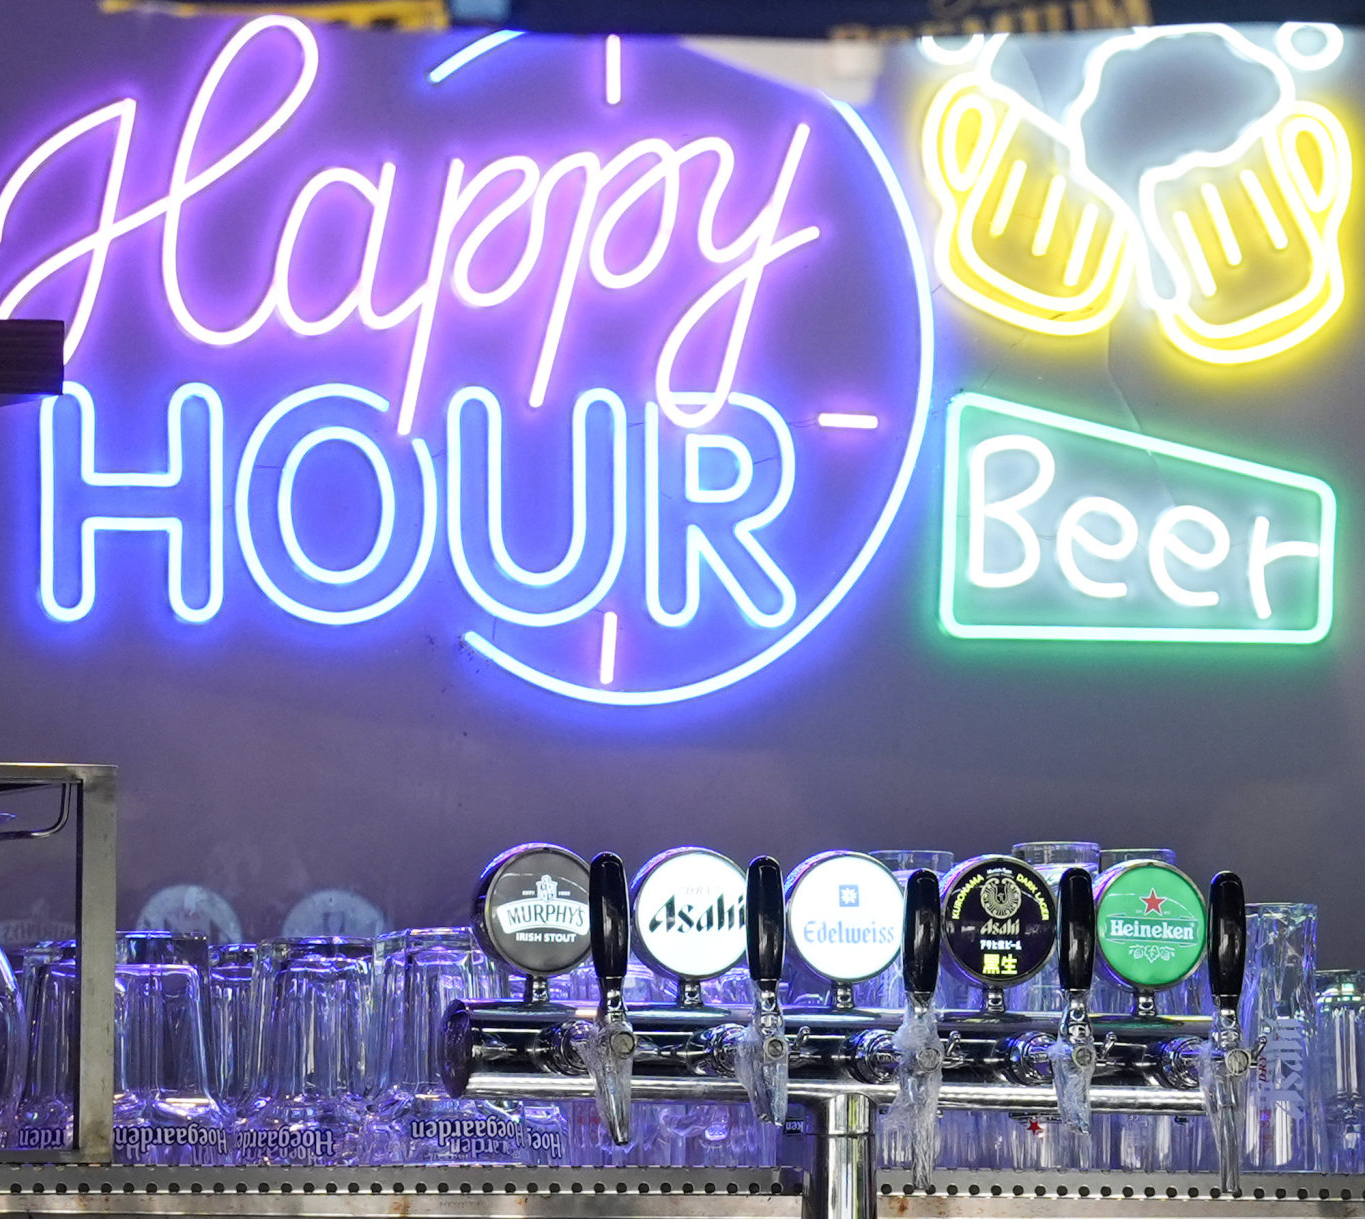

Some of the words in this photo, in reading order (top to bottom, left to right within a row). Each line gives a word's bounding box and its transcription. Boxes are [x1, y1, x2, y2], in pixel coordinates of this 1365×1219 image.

[39, 380, 797, 630] HOUR
[966, 434, 1321, 620] Beer
[951, 873, 985, 920] KURONAMA
[1016, 873, 1038, 894] DARK
[1035, 891, 1050, 921] LAGER
[506, 902, 586, 927] MURPHY'S
[648, 893, 747, 934] Asahi
[980, 918, 1020, 935] Asahi
[515, 932, 542, 943] IRISH
[543, 933, 577, 943] STOUT
[803, 919, 895, 945] Edelweiss
[1110, 919, 1194, 940] Heineken
[982, 953, 1018, 975] 黒生
[411, 1115, 525, 1147] Hoegaarden
